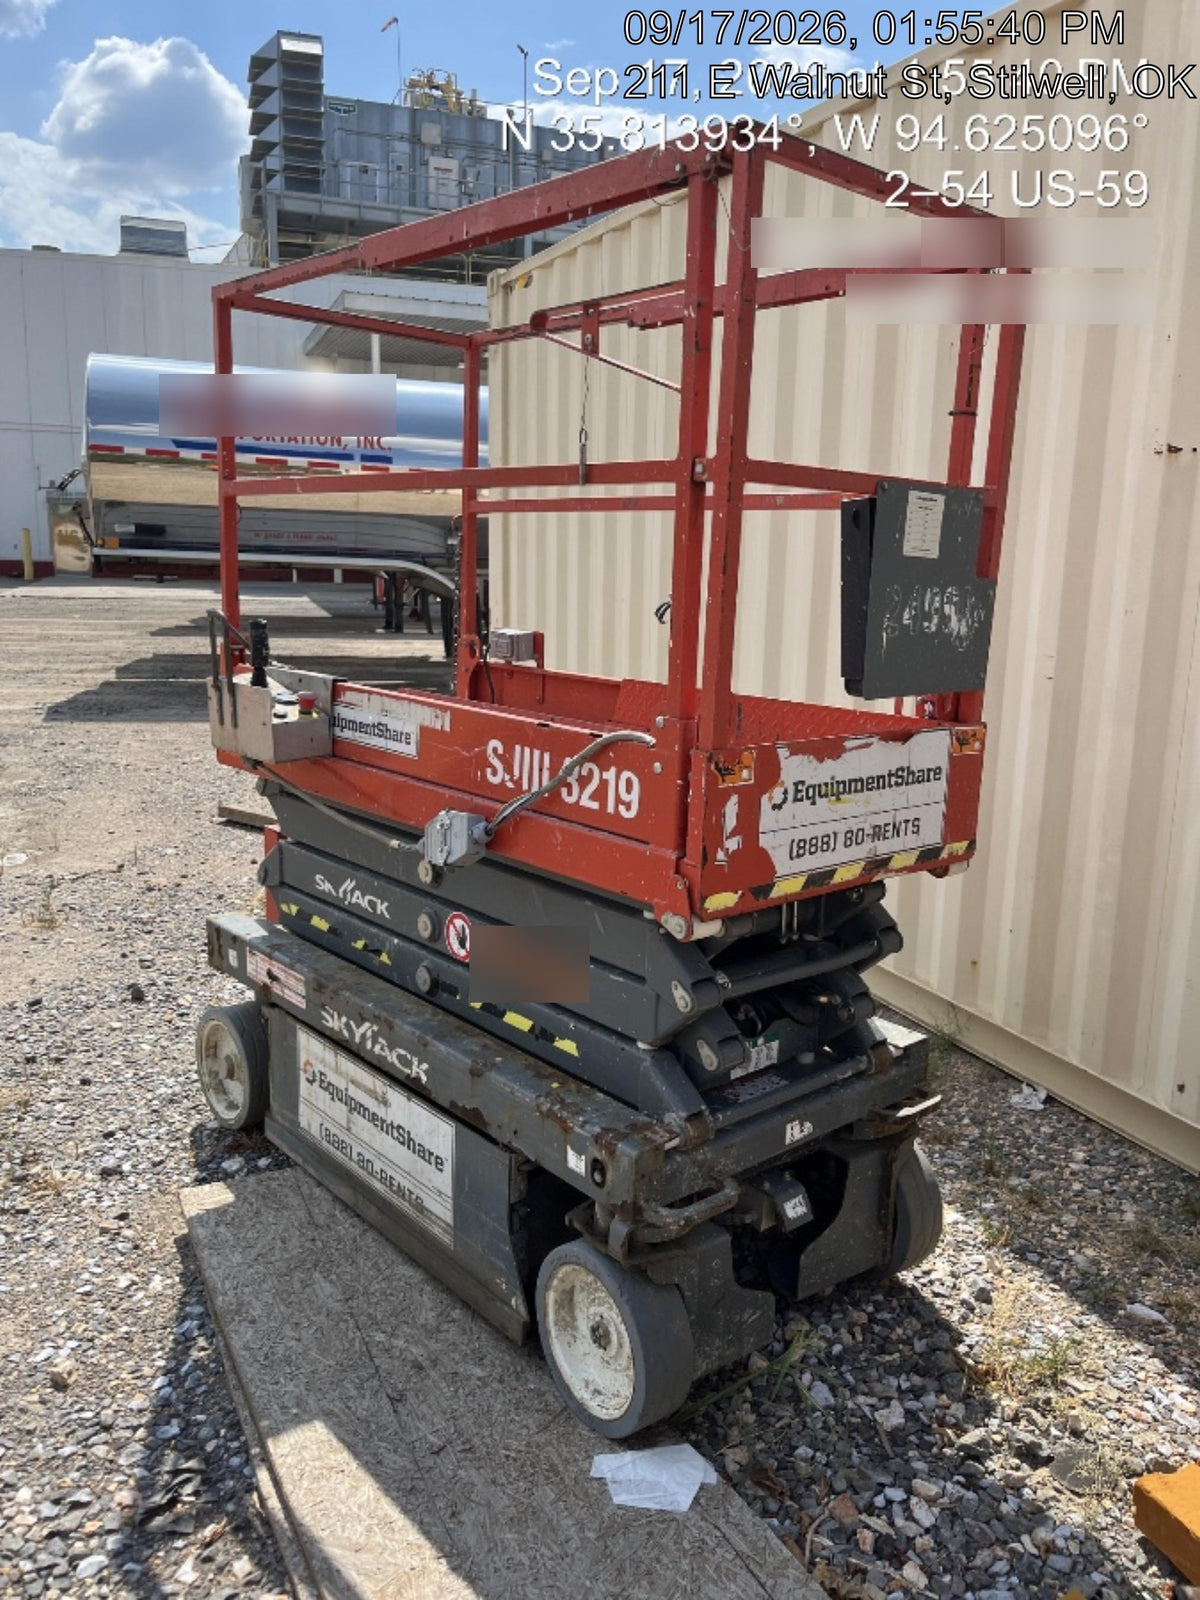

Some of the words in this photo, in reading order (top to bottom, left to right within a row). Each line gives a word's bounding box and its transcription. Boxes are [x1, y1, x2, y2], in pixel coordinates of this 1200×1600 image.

[560, 756, 640, 819] 3219
[792, 765, 943, 806] EquipmentShare
[788, 831, 838, 861] (888)
[843, 817, 921, 849] 80-RENTS
[314, 873, 392, 919] SKYJACK
[319, 1005, 430, 1084] SKYJACK
[317, 1070, 446, 1174] EquipmentShare
